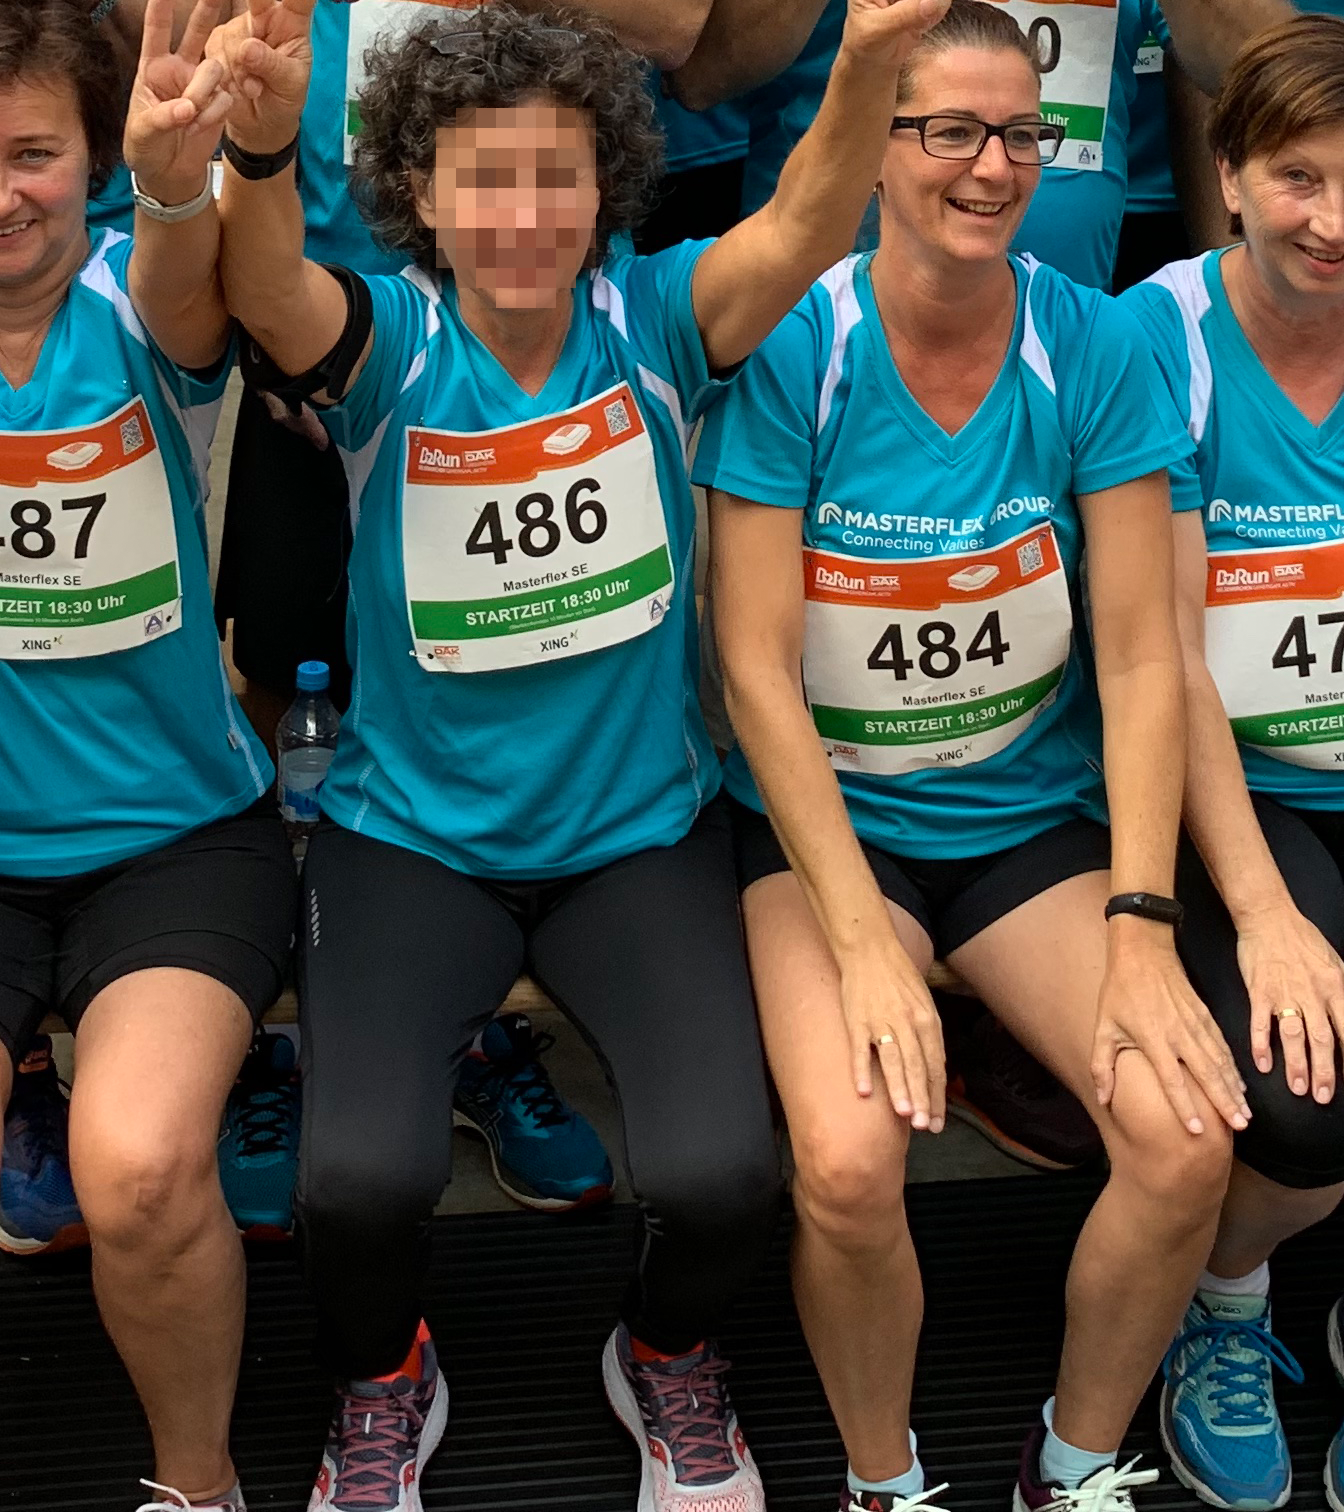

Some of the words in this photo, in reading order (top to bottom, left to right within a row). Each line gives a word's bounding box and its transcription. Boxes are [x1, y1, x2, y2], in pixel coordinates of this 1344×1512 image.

[1047, 113, 1070, 128] Uhr
[465, 477, 607, 565] 486
[845, 511, 985, 536] MASTERFLEX
[842, 531, 934, 554] Connecting
[1236, 525, 1326, 540] Connecting
[63, 575, 81, 586] SE
[503, 570, 568, 592] Masterflex
[572, 563, 589, 575] SE
[48, 600, 92, 615] 18:30
[97, 593, 126, 610] Uhr
[466, 599, 556, 626] STARTZEIT
[560, 588, 602, 610] 18:30
[605, 578, 631, 598] Uhr
[22, 639, 52, 650] XING
[540, 636, 569, 652] XING
[867, 610, 1010, 681] 484
[902, 691, 966, 707] Masterflex
[969, 685, 986, 697] SE
[864, 715, 953, 734] STARTZEIT
[957, 706, 997, 726] 18:30
[1000, 696, 1025, 715] Uhr
[935, 749, 964, 762] XING
